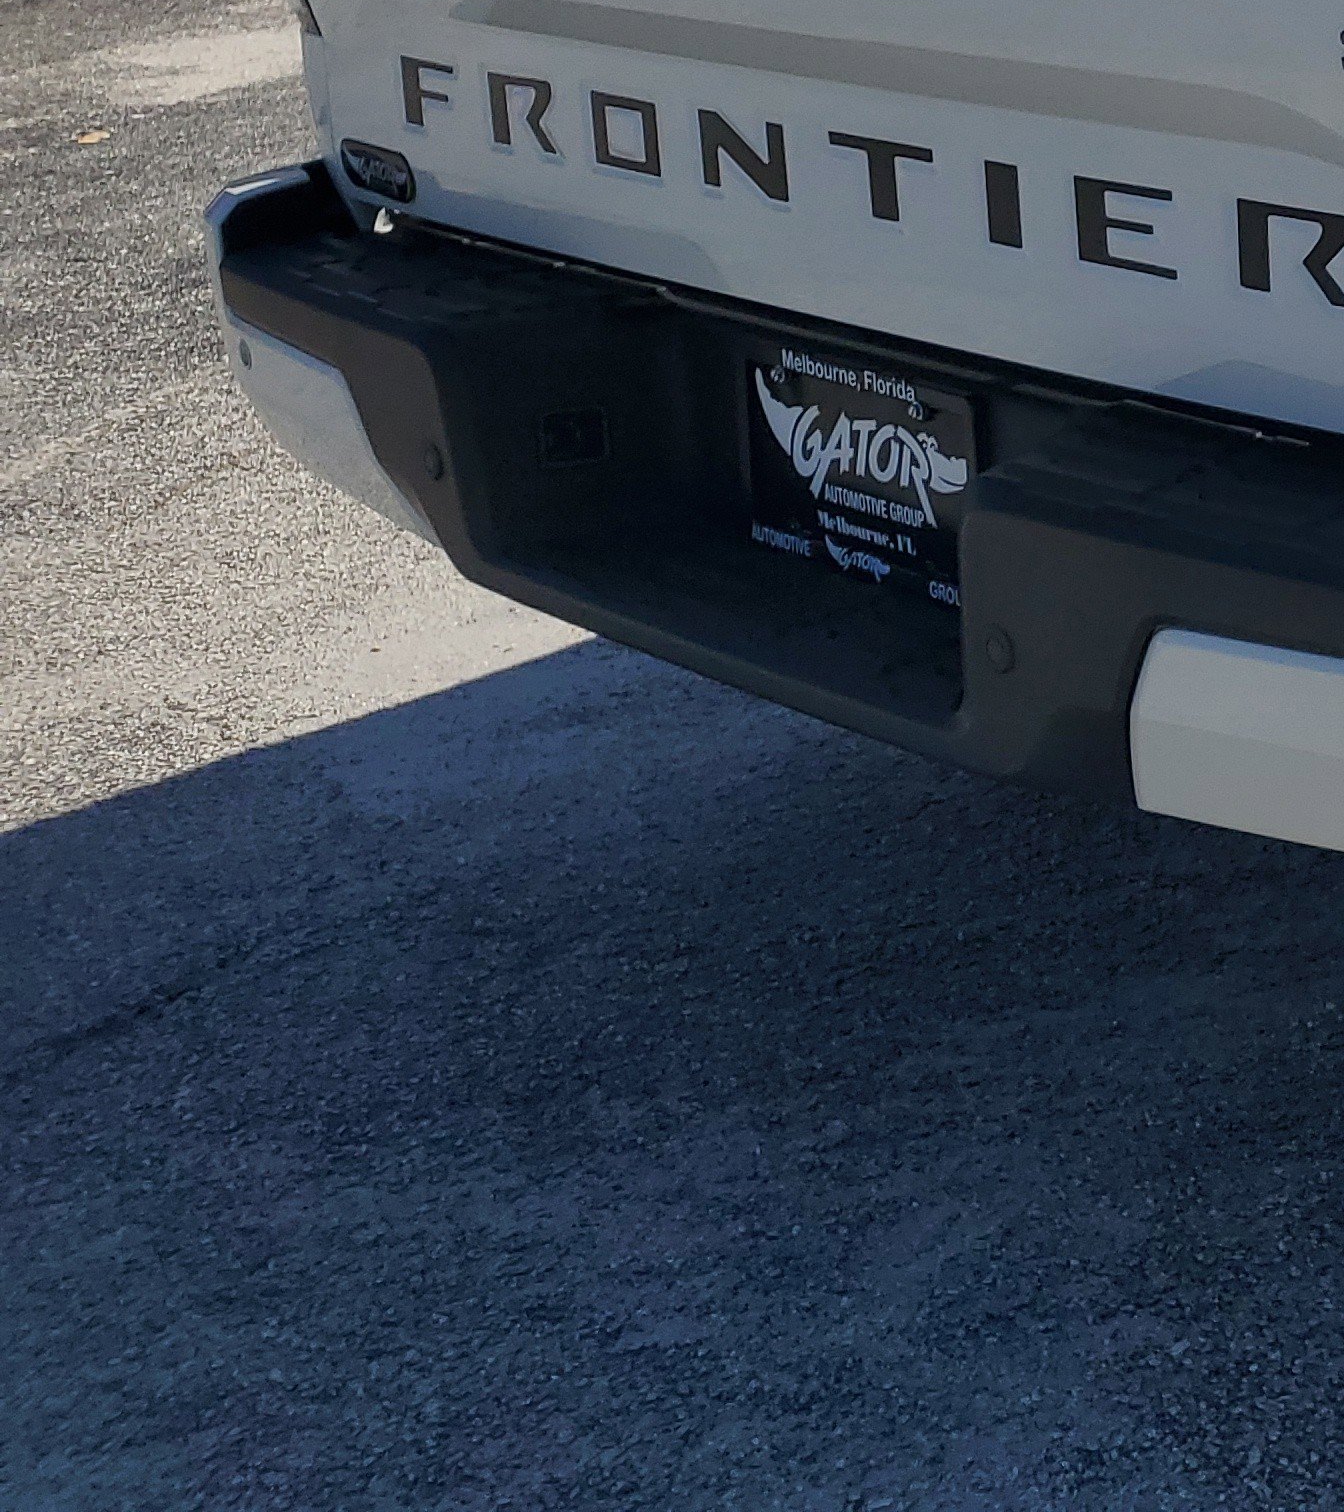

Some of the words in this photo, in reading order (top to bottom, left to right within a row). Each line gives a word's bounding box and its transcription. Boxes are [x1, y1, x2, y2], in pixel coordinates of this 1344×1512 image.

[782, 348, 862, 392] Melbourne,
[864, 370, 915, 402] Florida
[793, 404, 937, 529] GATOR
[824, 483, 888, 519] AUTOMOTIVE
[890, 502, 925, 528] GROUP
[752, 520, 811, 556] AUTOMOTIVE
